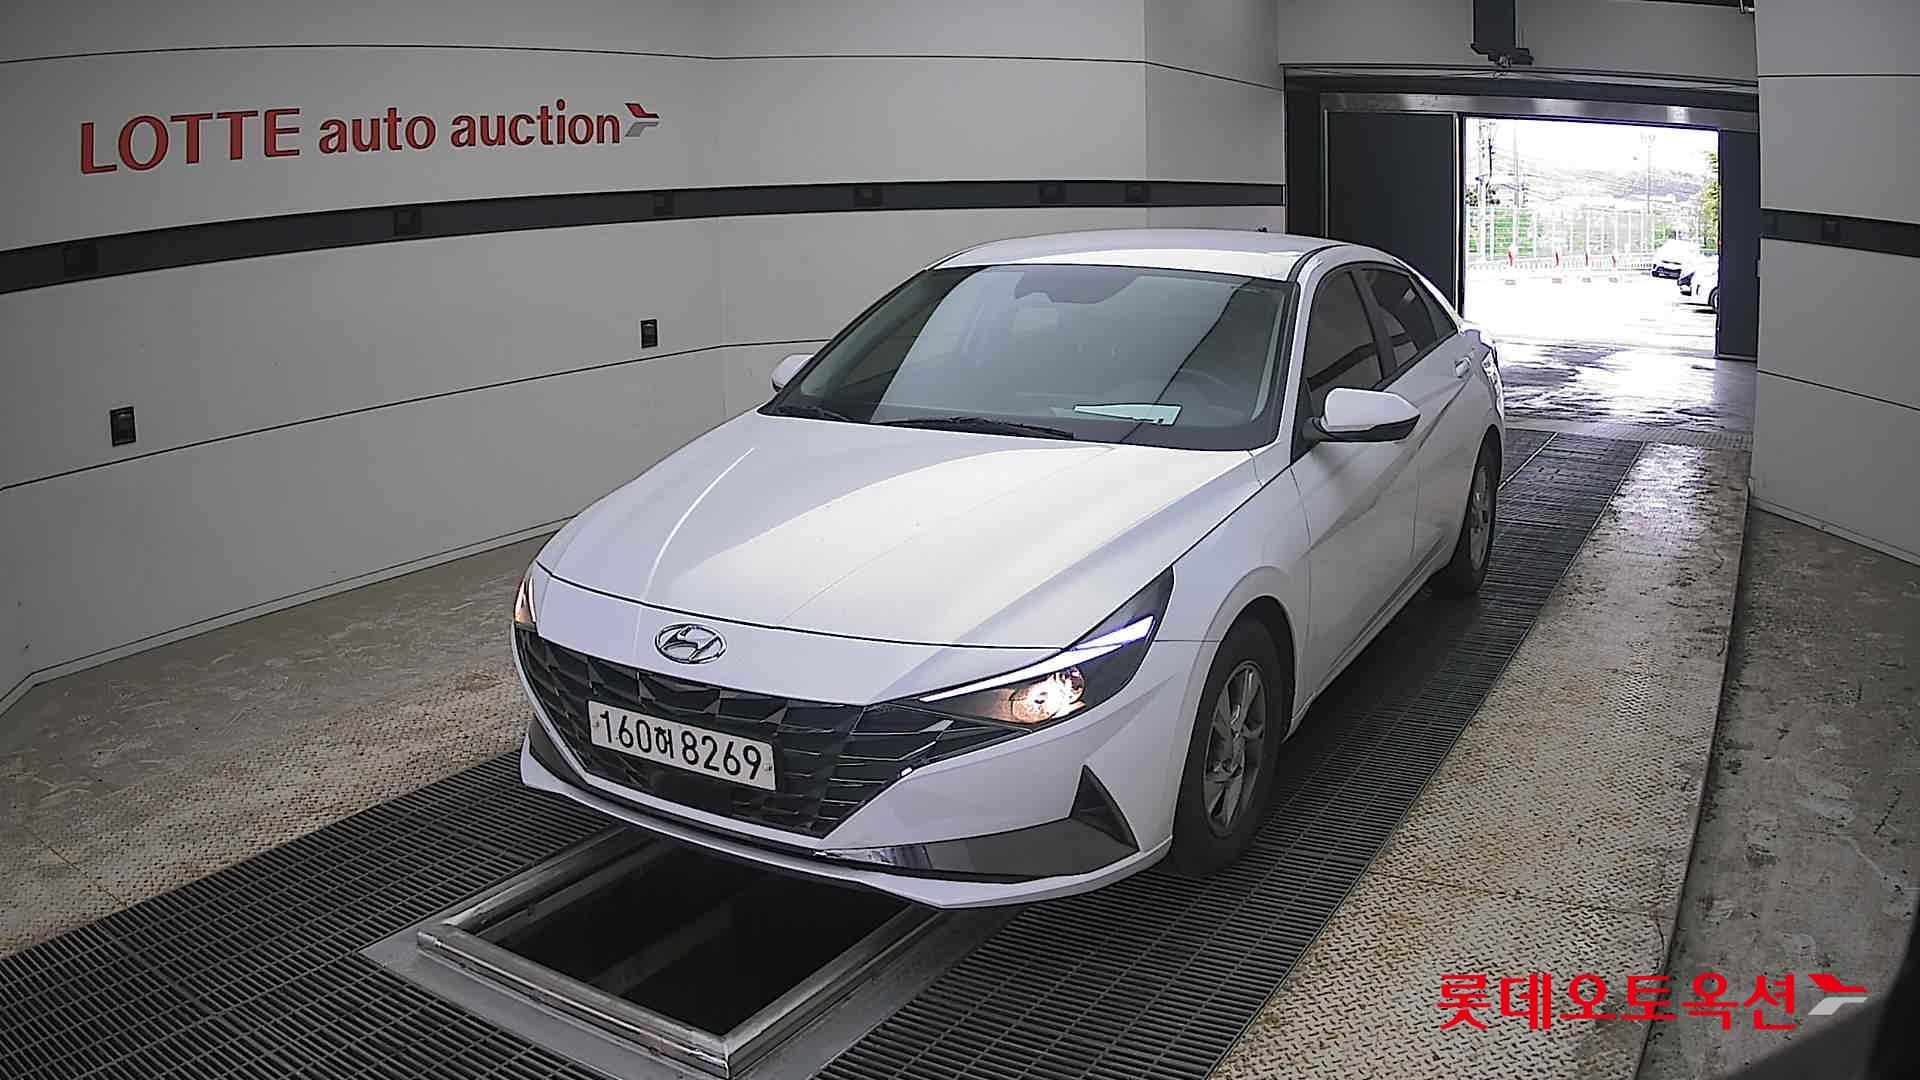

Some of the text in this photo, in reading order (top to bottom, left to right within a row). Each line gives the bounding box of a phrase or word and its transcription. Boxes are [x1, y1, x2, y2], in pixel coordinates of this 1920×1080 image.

[80, 99, 621, 174] LOTTE auto auction
[680, 730, 763, 781] 8269
